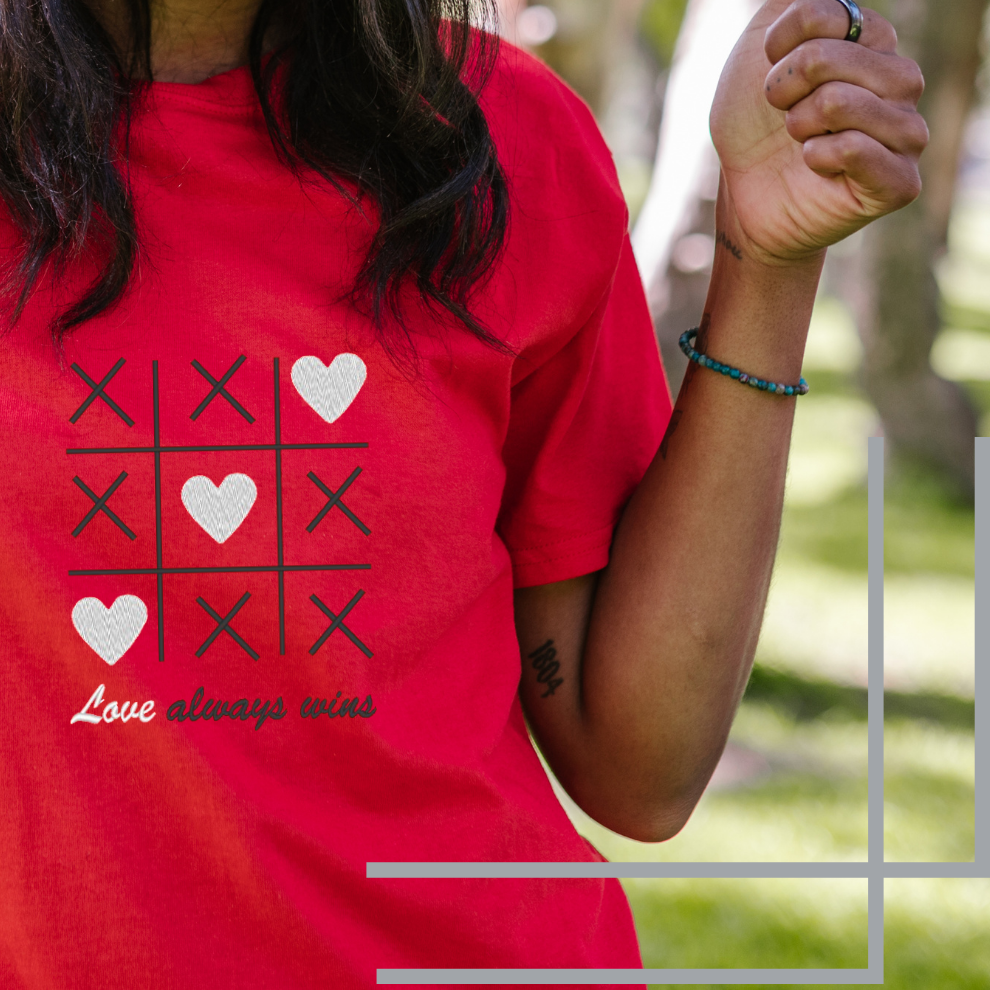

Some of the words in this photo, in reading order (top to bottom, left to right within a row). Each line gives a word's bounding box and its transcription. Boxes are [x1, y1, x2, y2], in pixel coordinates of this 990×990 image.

[70, 683, 157, 725] Love
[166, 686, 288, 731] always
[299, 690, 377, 720] wins
